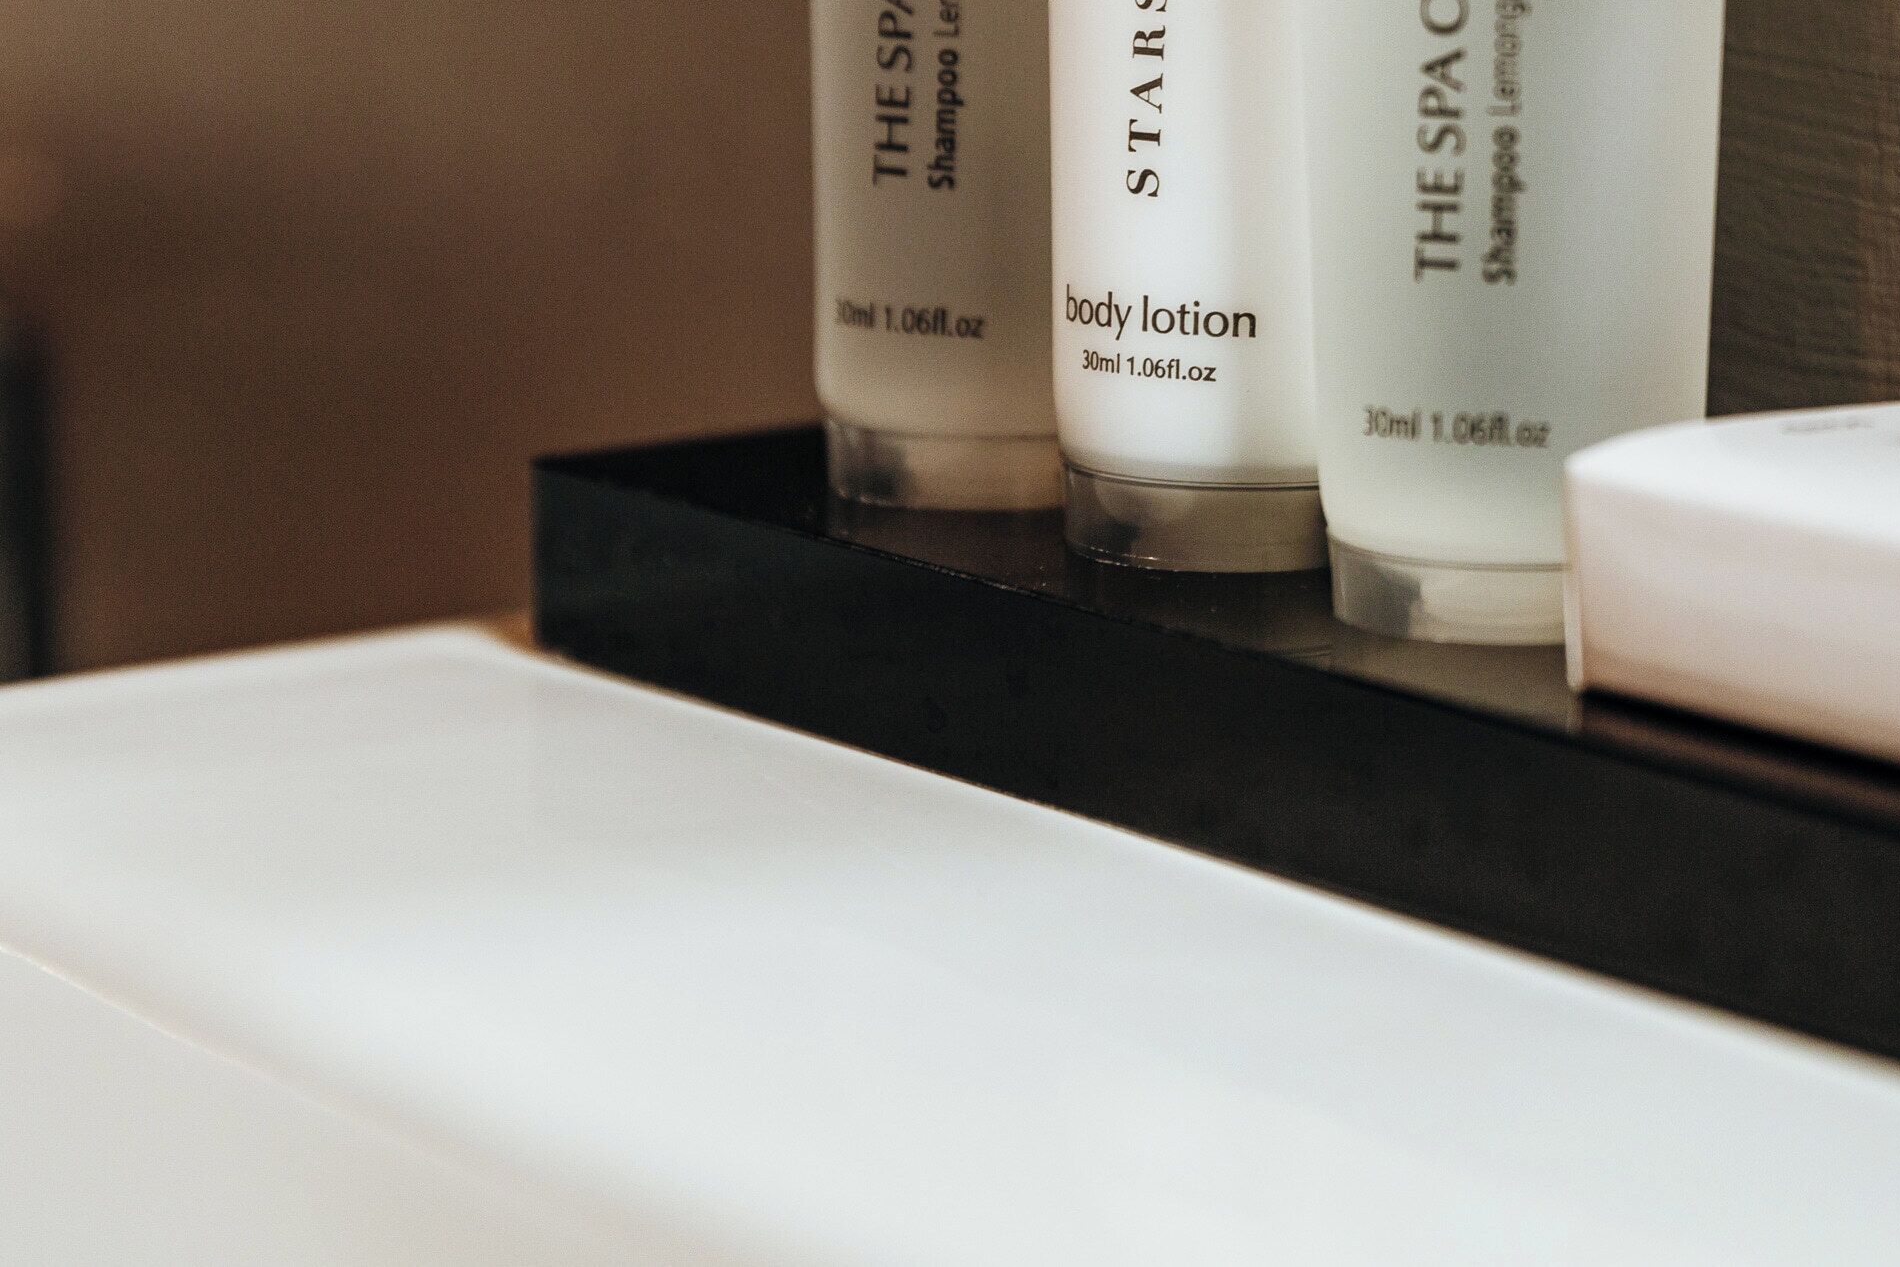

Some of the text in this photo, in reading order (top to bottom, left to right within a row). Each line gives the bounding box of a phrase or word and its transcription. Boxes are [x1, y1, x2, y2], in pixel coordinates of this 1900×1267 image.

[871, 79, 913, 188] THE
[927, 46, 966, 193] Shampoo
[1416, 47, 1468, 156] SPA
[1413, 164, 1465, 283] THE
[1481, 124, 1525, 287] Shampoo
[1066, 284, 1256, 340] body lotion
[1082, 349, 1217, 382] 30ml 1.06fl.oz
[1364, 405, 1421, 441] 30ml
